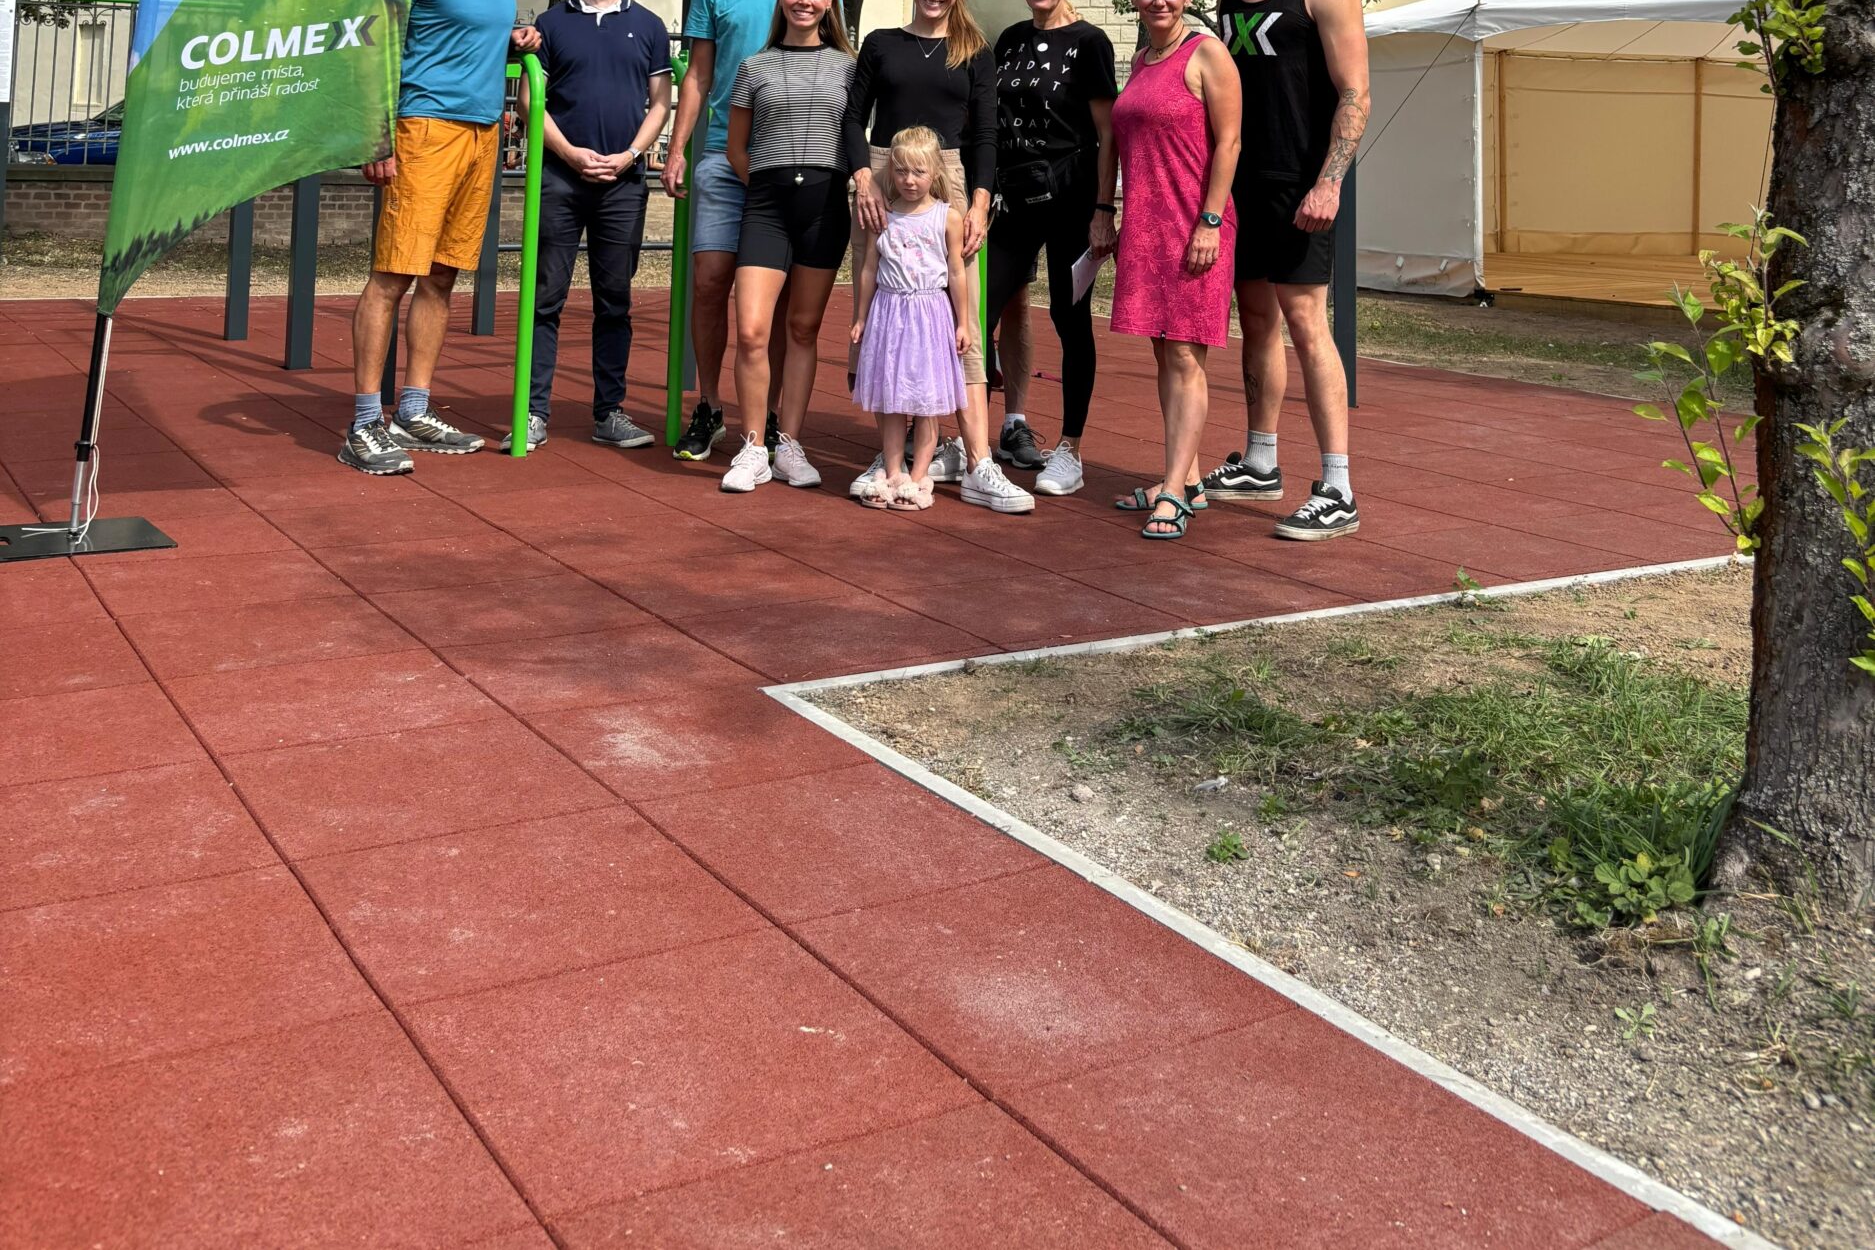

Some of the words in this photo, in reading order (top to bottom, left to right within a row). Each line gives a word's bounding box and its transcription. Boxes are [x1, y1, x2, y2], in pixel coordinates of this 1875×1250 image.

[180, 15, 366, 70] COLMEX
[179, 71, 256, 92] budujeme
[260, 65, 305, 81] místa,
[996, 77, 1062, 92] IGHT
[176, 91, 214, 111] která
[218, 83, 272, 105] přináší
[275, 77, 320, 96] radost
[997, 97, 1051, 110] ILL
[1000, 116, 1052, 129] NDAY
[168, 129, 290, 160] www.colmex.cz
